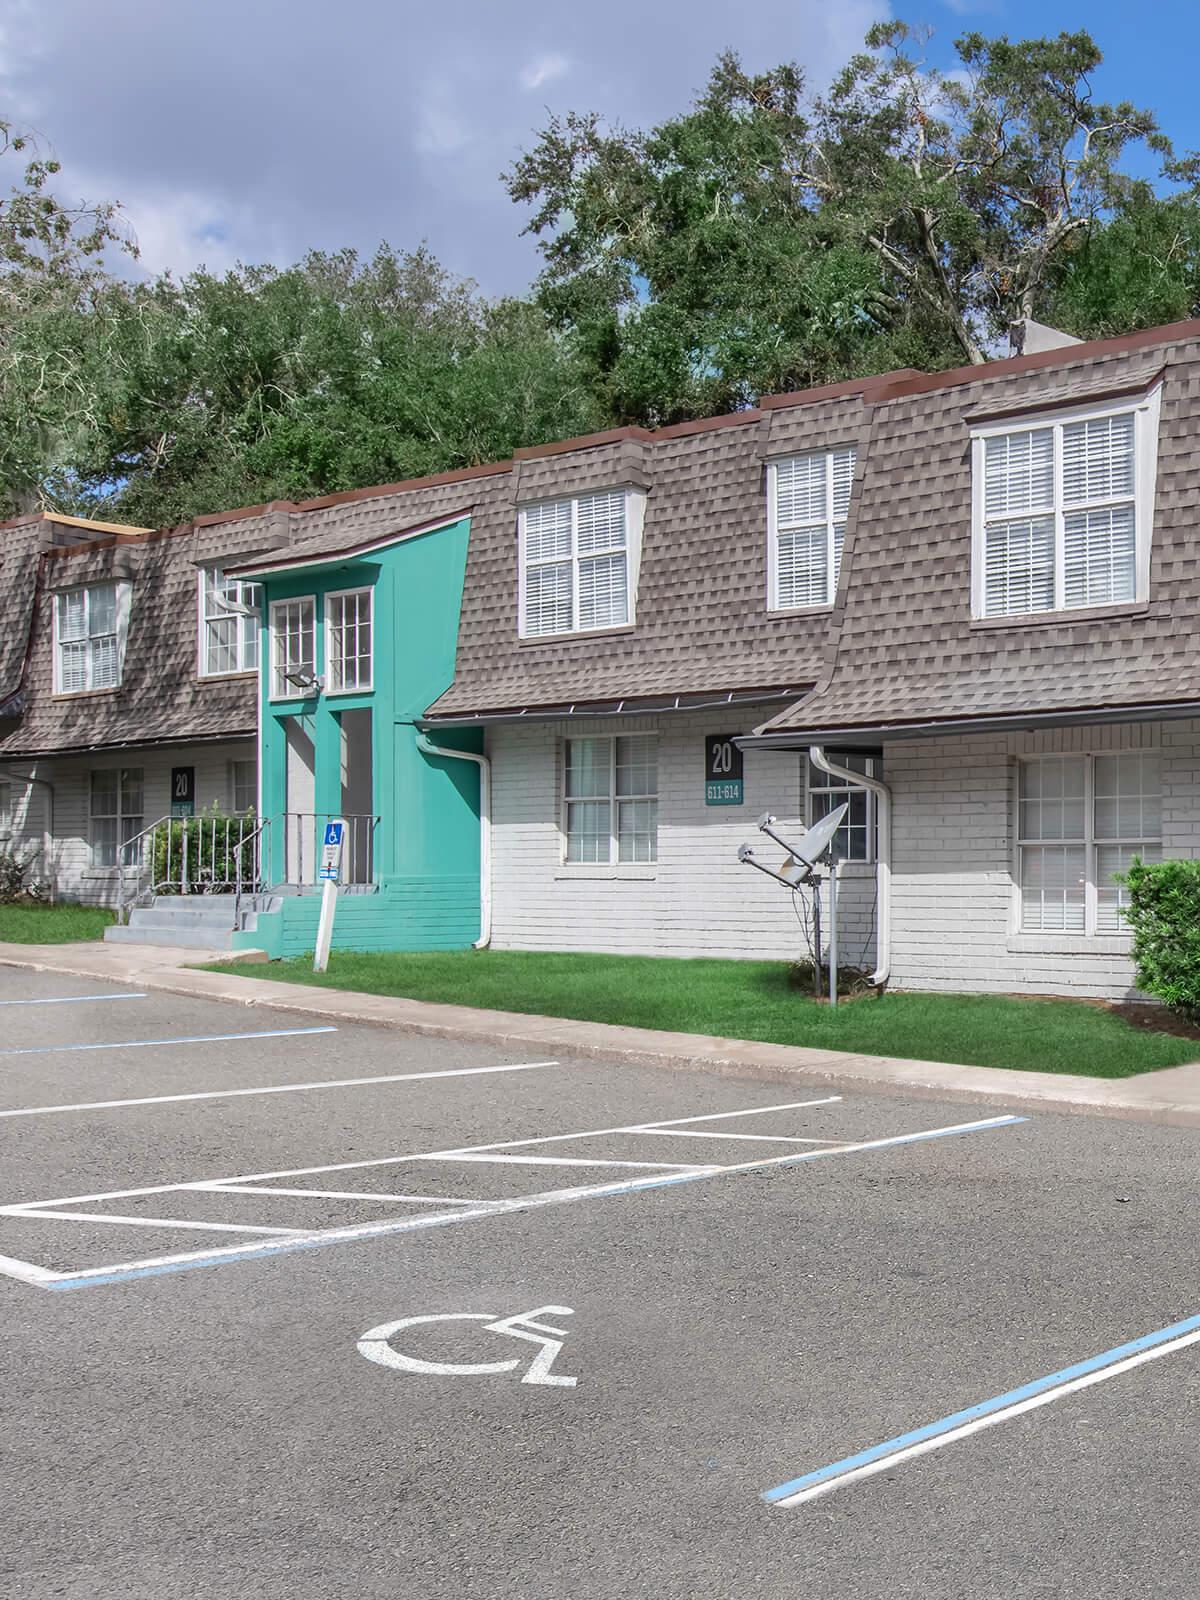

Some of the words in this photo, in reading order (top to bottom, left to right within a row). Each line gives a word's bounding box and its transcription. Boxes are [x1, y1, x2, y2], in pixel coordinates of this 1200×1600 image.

[712, 742, 732, 773] 20
[176, 773, 188, 797] 20
[707, 784, 739, 800] 611-614
